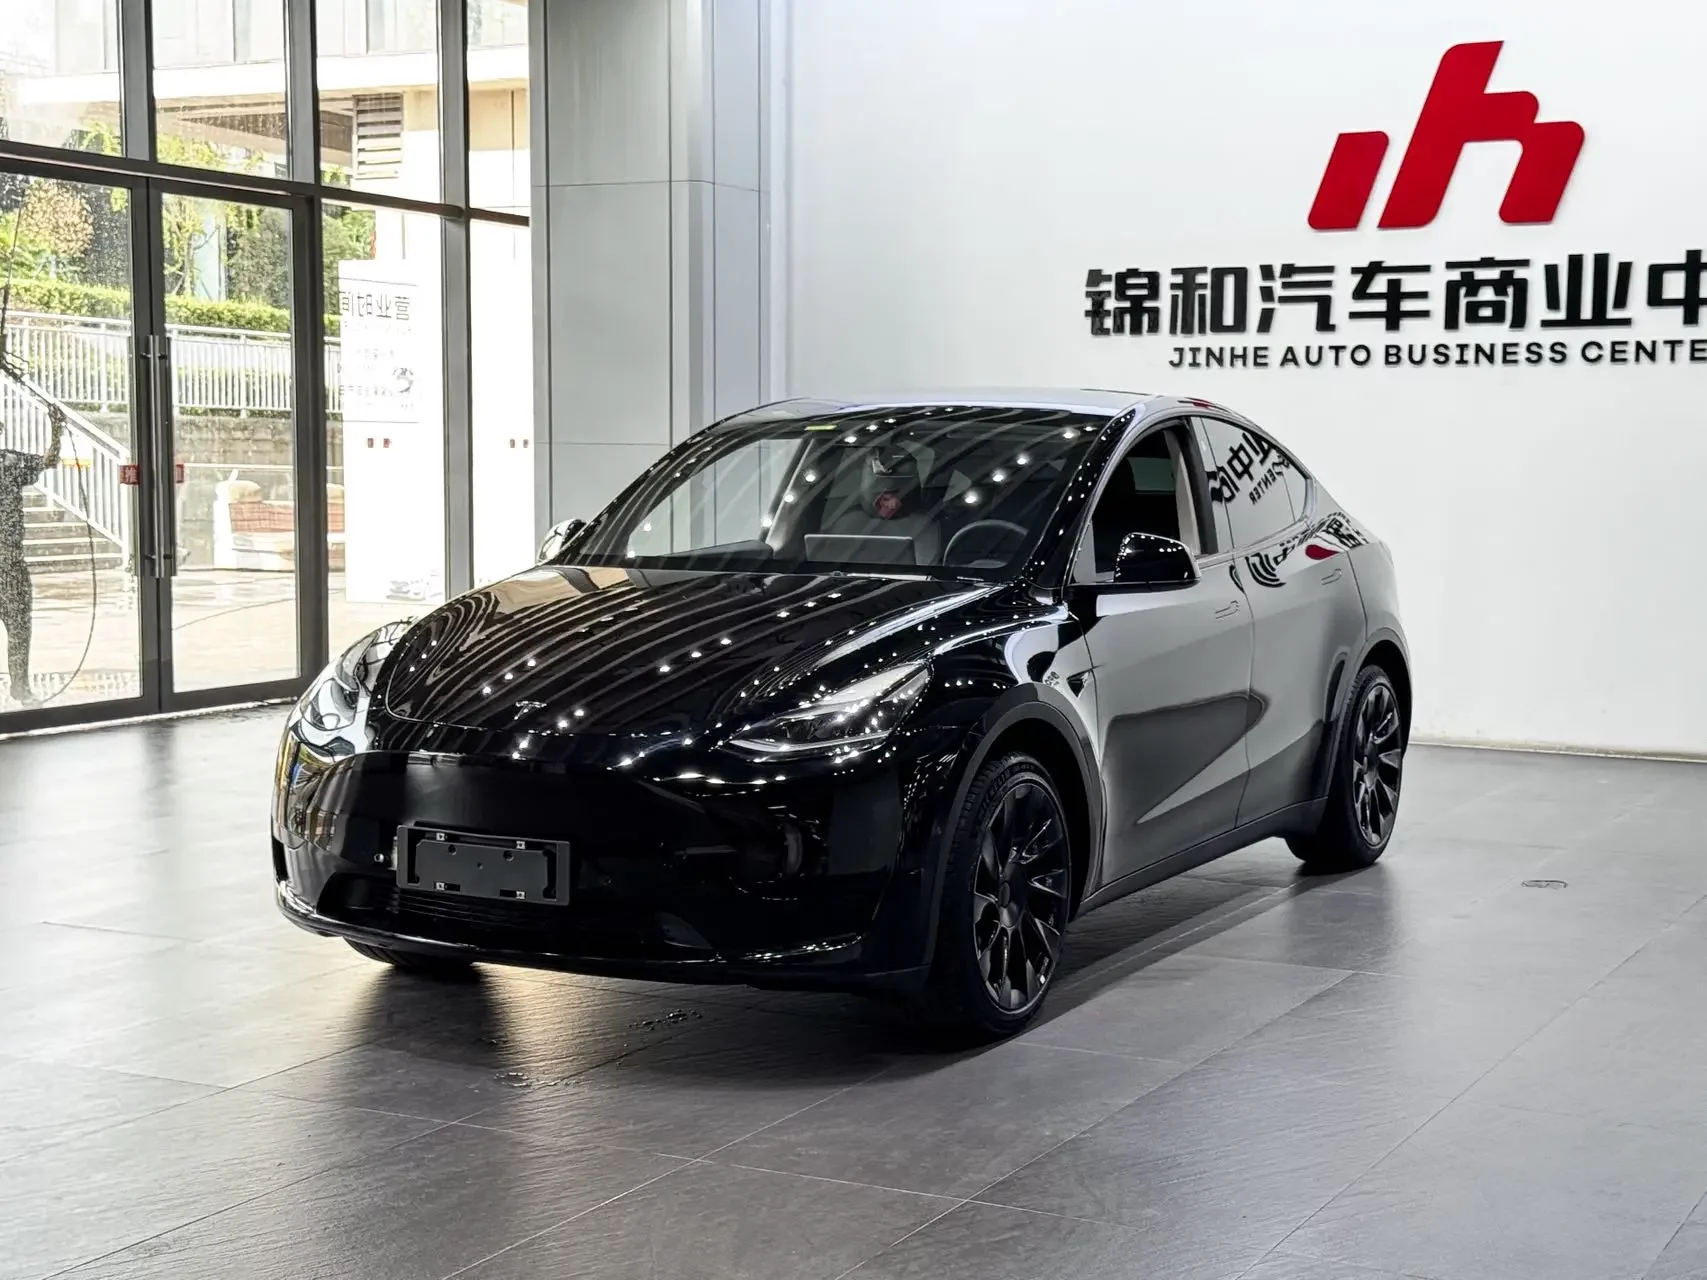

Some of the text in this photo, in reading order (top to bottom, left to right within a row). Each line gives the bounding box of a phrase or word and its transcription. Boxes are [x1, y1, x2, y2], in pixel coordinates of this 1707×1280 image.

[1084, 249, 1707, 336] 锦和汽车商业中
[1168, 339, 1707, 369] JINHE AUTO BUSINESS CENTE
